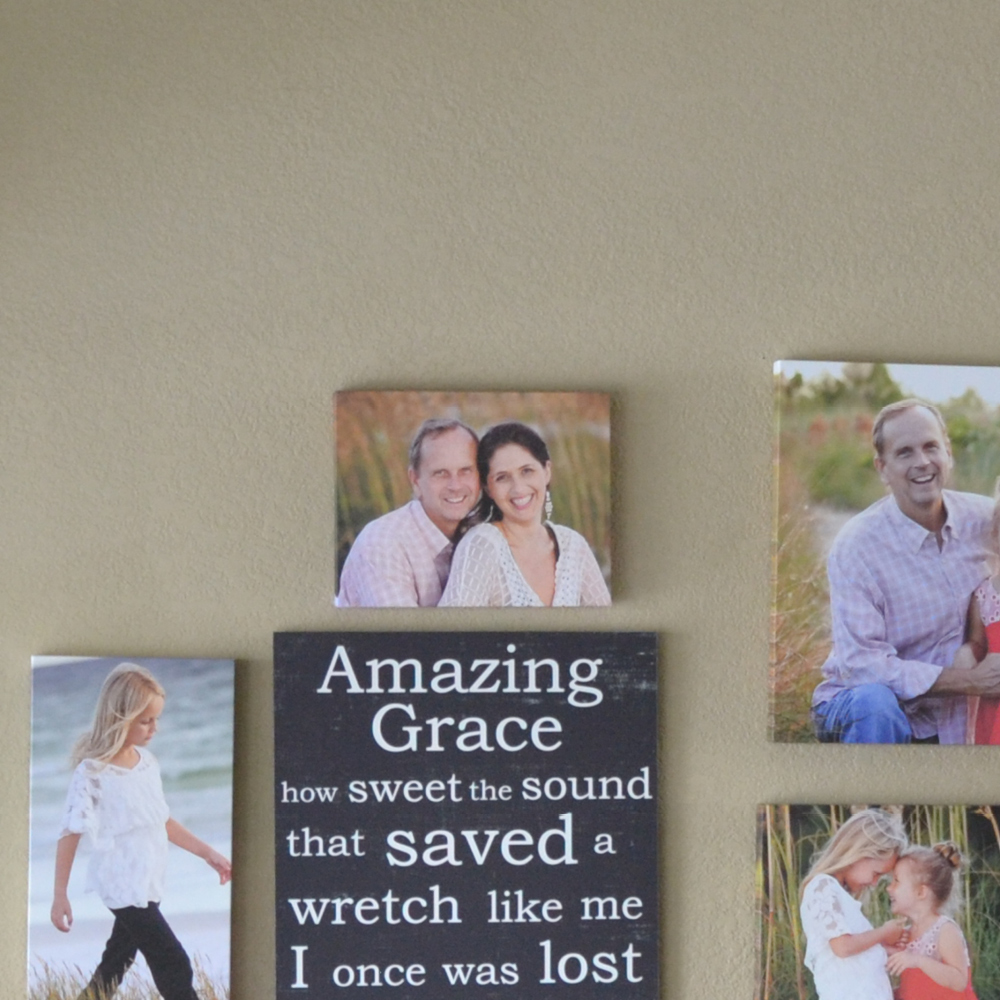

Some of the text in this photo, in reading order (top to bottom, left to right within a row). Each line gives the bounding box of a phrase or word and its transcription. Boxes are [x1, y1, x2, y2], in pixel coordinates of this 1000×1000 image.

[316, 644, 604, 708] Amazing
[372, 703, 563, 753] Grace
[280, 765, 653, 804] how sweet the sound
[286, 812, 617, 867] that saved a
[287, 884, 644, 926] wretch like me
[290, 939, 644, 989] I once was lost
